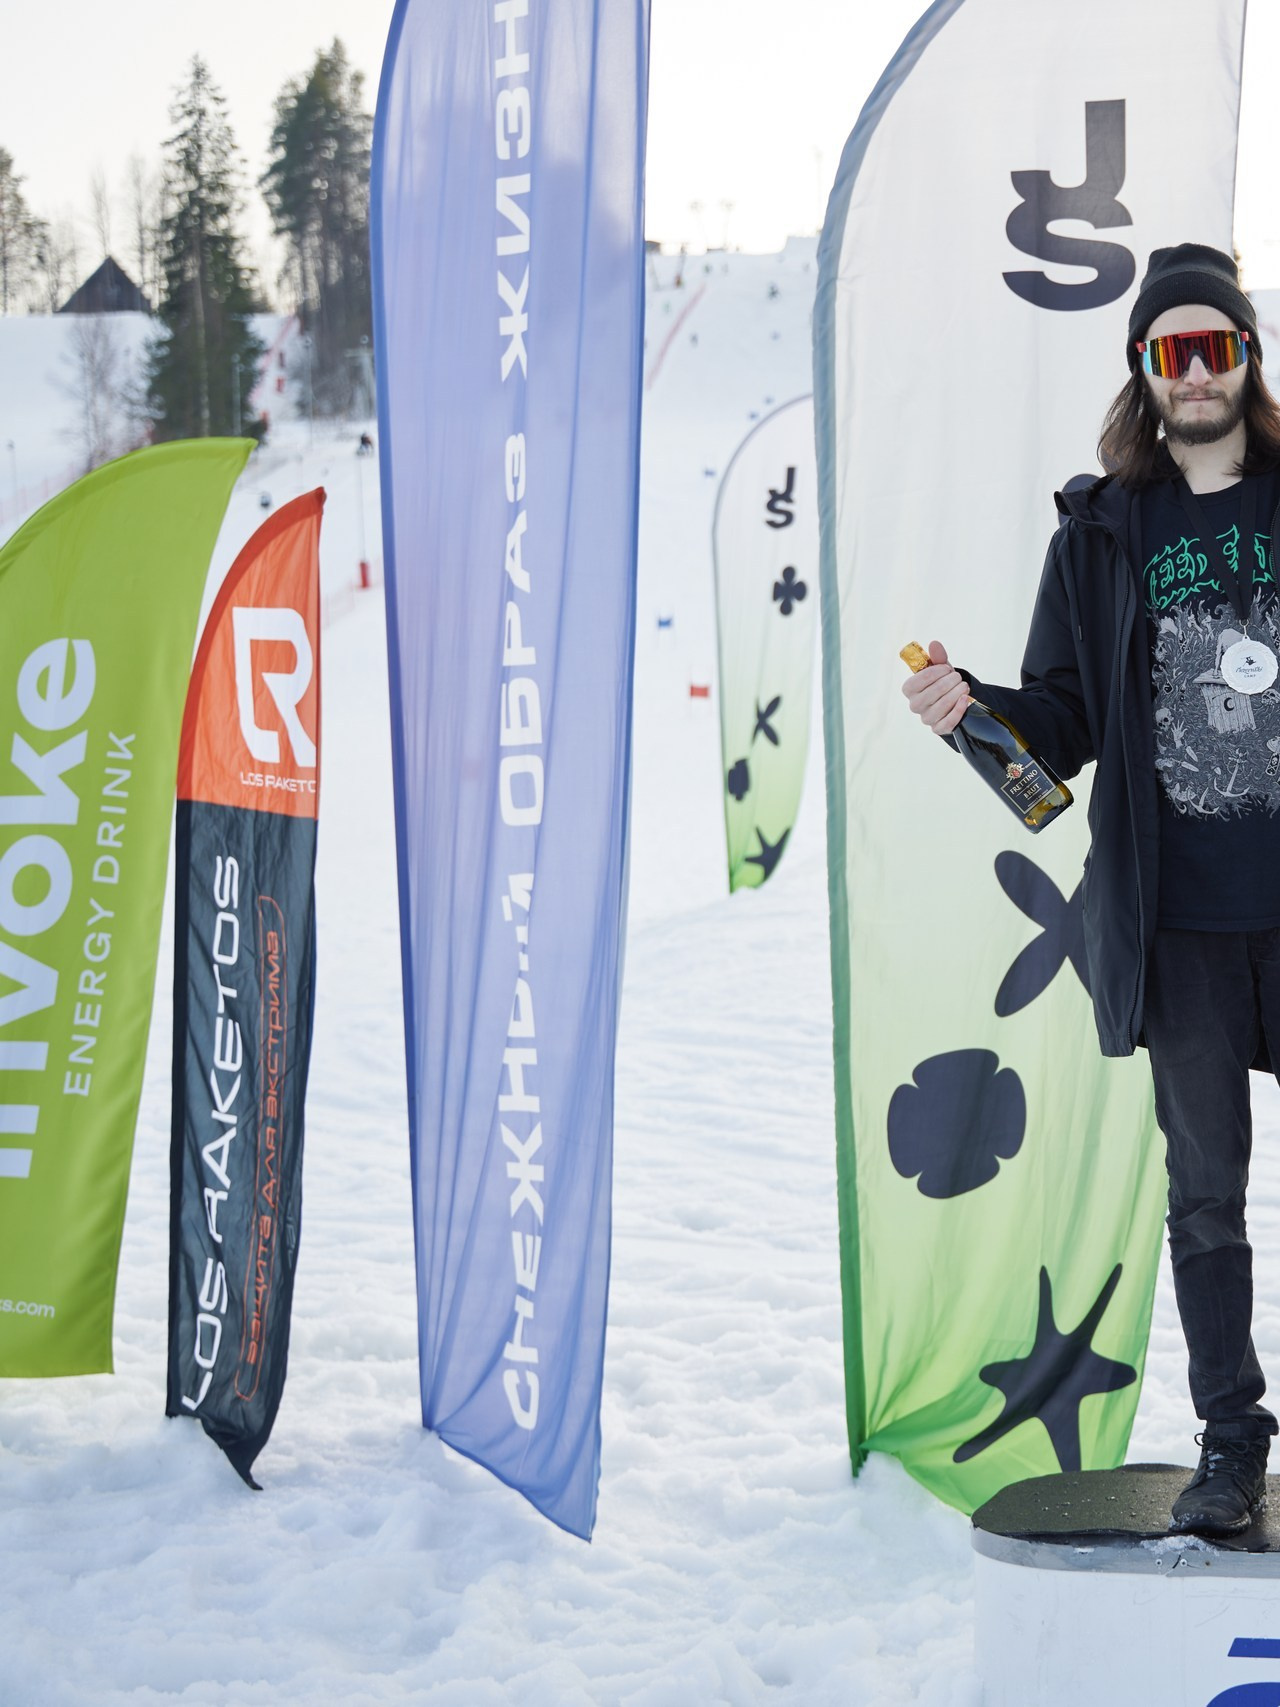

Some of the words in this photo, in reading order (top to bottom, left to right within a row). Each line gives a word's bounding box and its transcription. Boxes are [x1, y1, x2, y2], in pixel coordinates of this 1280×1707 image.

[500, 432, 543, 827] ОБРАЗ
[240, 771, 264, 787] LOS
[1009, 769, 1038, 795] FRETTINO
[1023, 782, 1040, 799] BRUT
[63, 903, 114, 1097] ENERGY
[92, 730, 137, 886] DRINK
[201, 854, 244, 1246] RAKETOS
[0, 1298, 56, 1320] s.com
[181, 1254, 229, 1413] LOS
